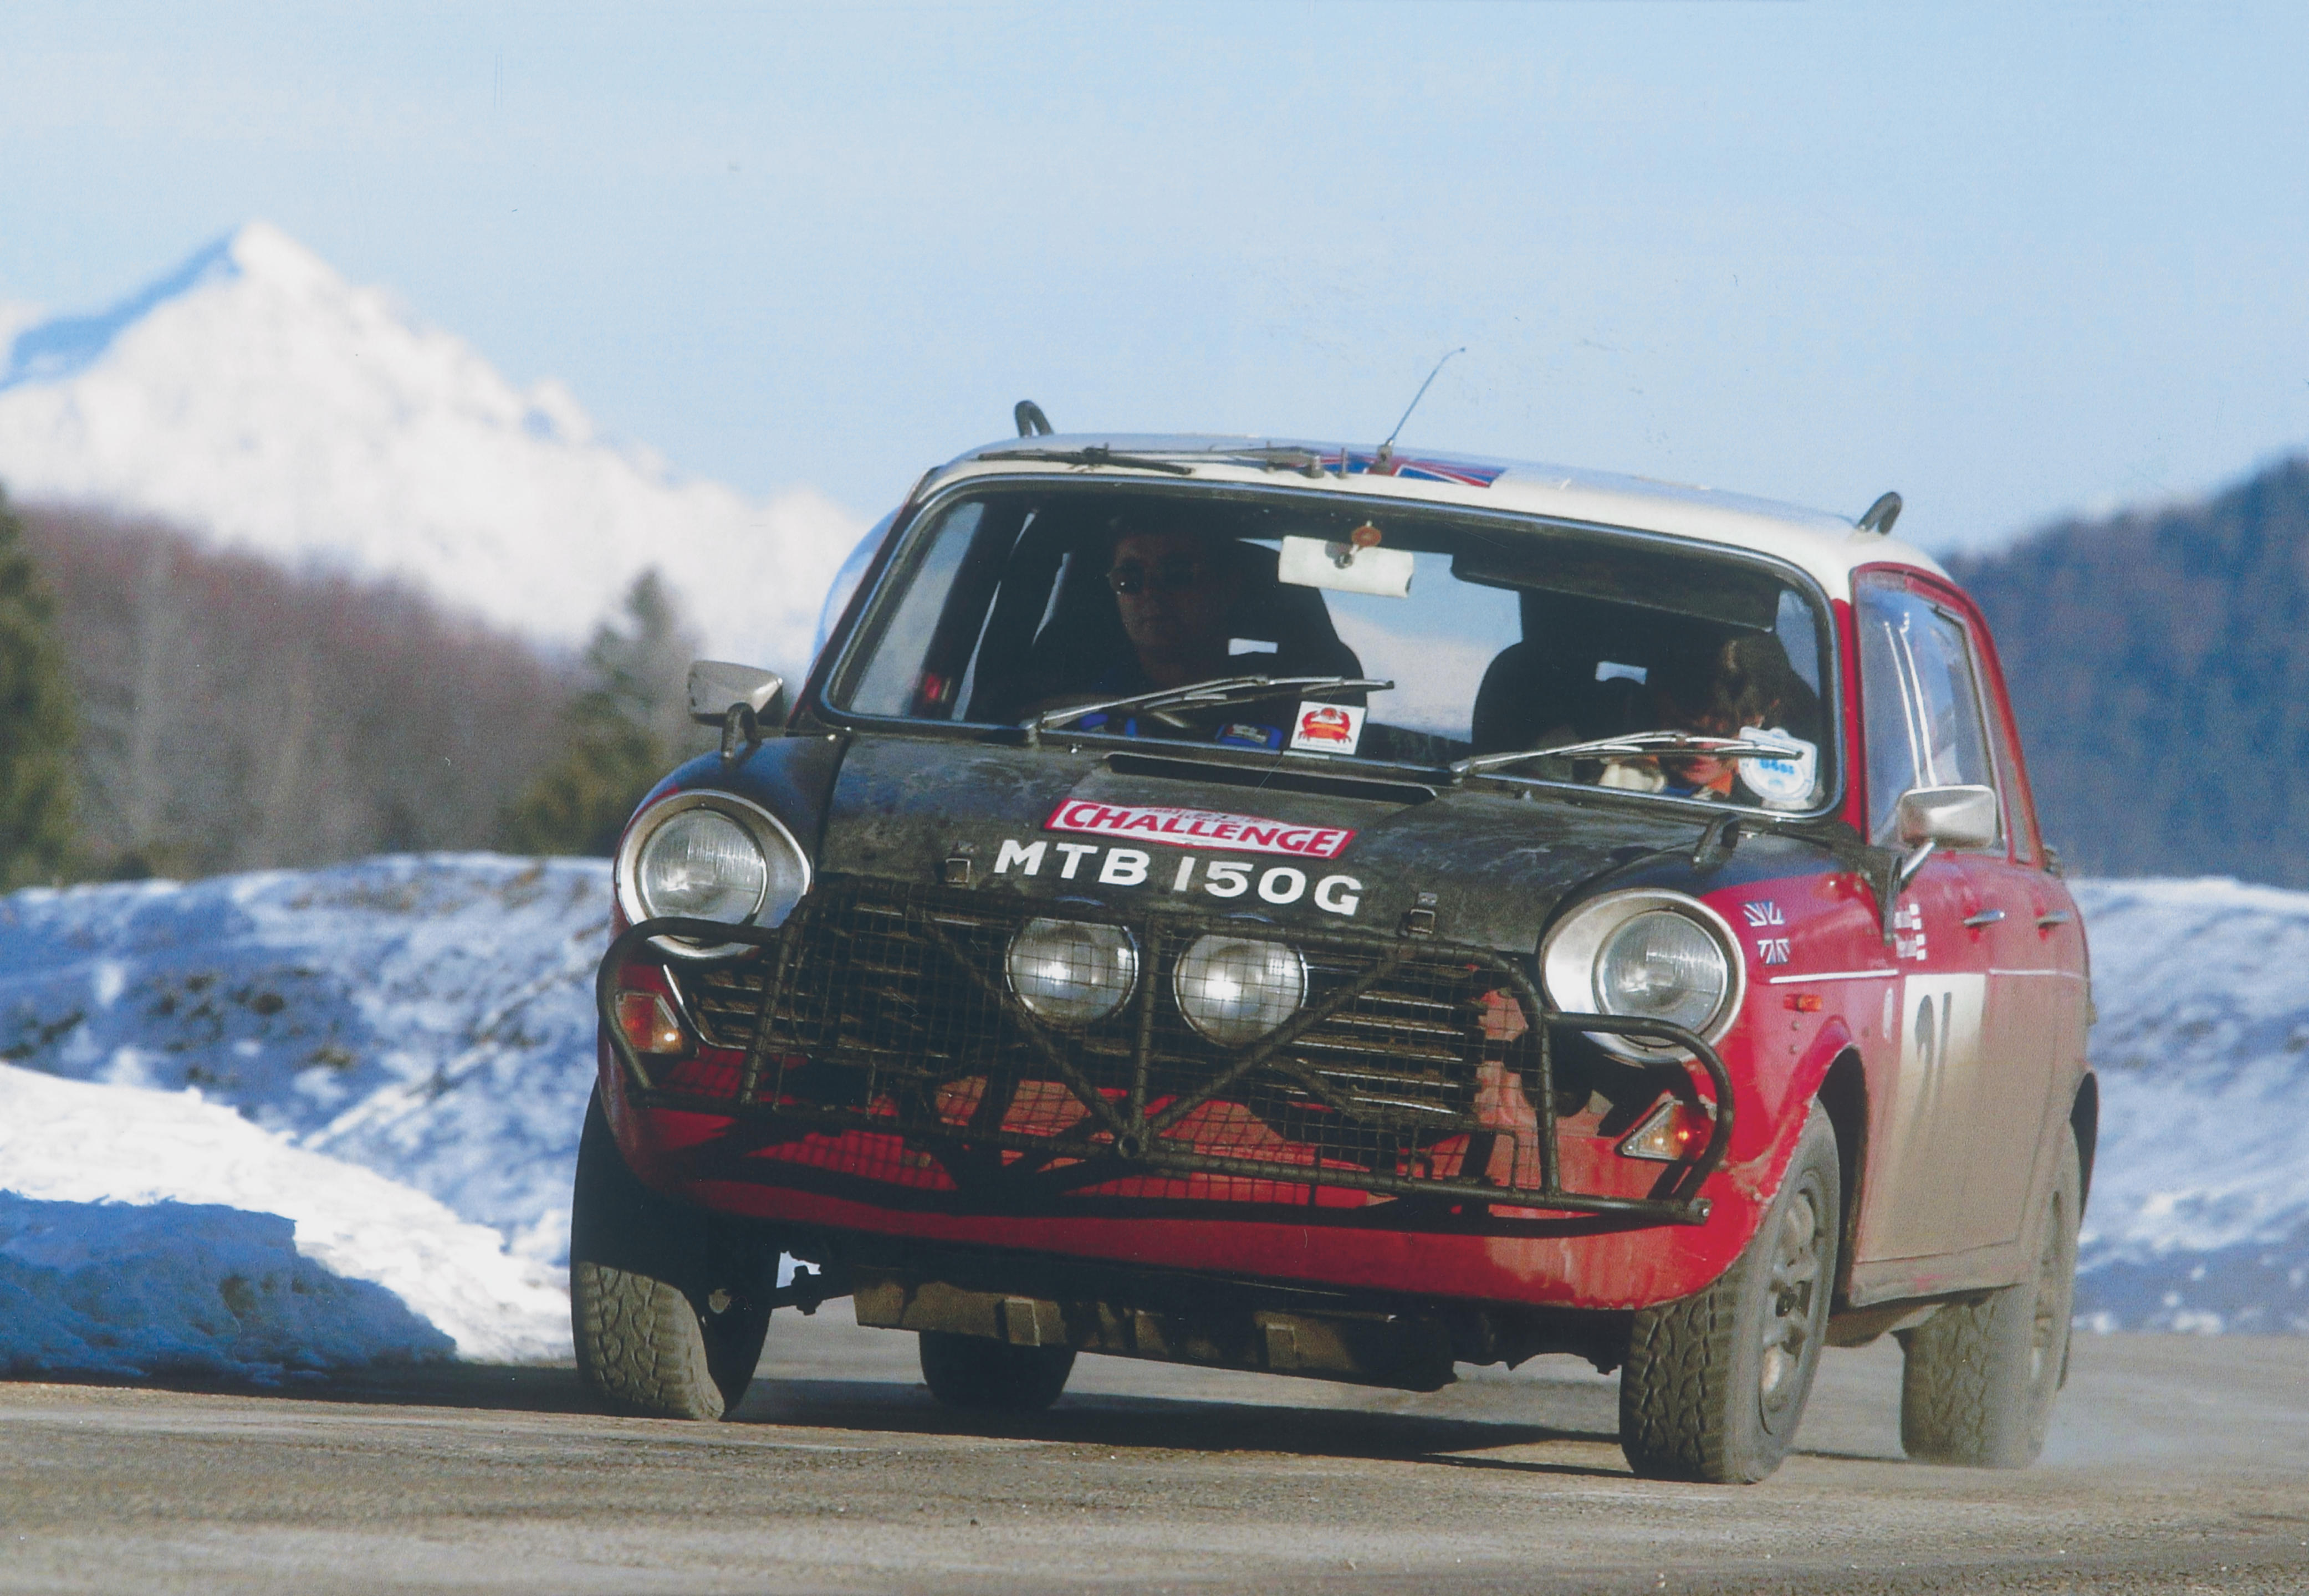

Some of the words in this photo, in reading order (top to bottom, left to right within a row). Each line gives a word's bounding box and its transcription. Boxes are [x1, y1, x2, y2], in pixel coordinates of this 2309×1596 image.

[1062, 803, 1340, 855] CHALLENGE
[993, 839, 1151, 886] MTB
[1173, 856, 1363, 916] 150G
